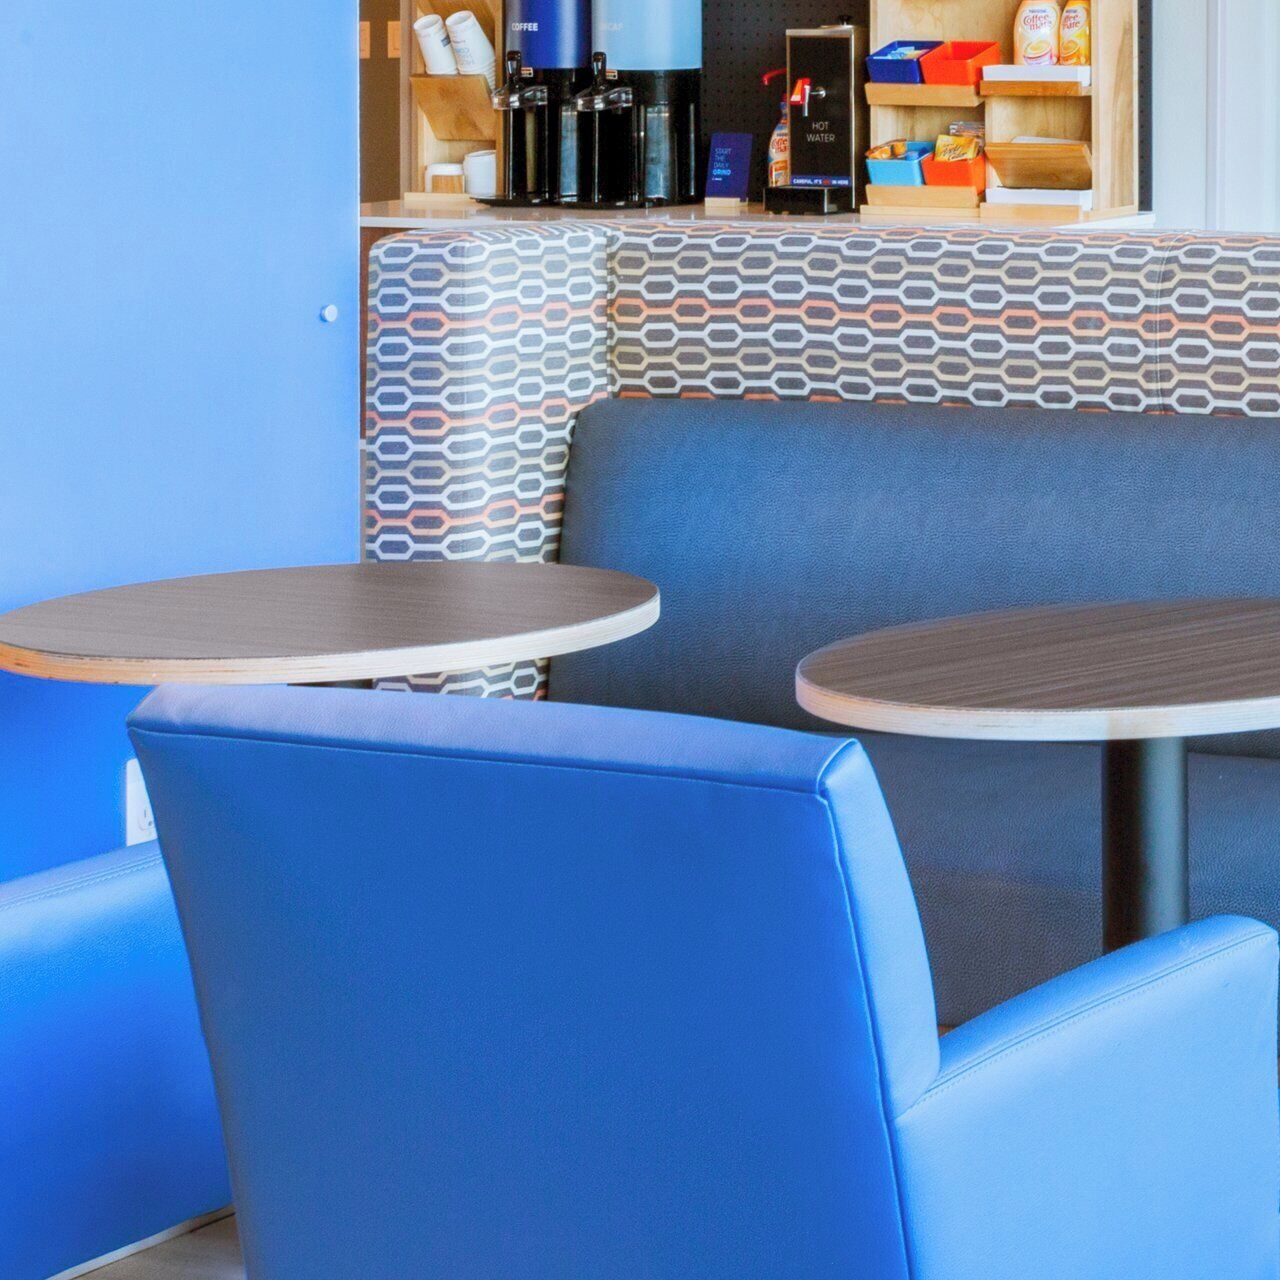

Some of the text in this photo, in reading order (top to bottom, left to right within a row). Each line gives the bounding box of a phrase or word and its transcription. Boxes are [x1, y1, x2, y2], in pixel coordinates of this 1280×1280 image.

[511, 22, 539, 32] COFFEE
[812, 121, 829, 131] HOT
[806, 133, 836, 143] WATER
